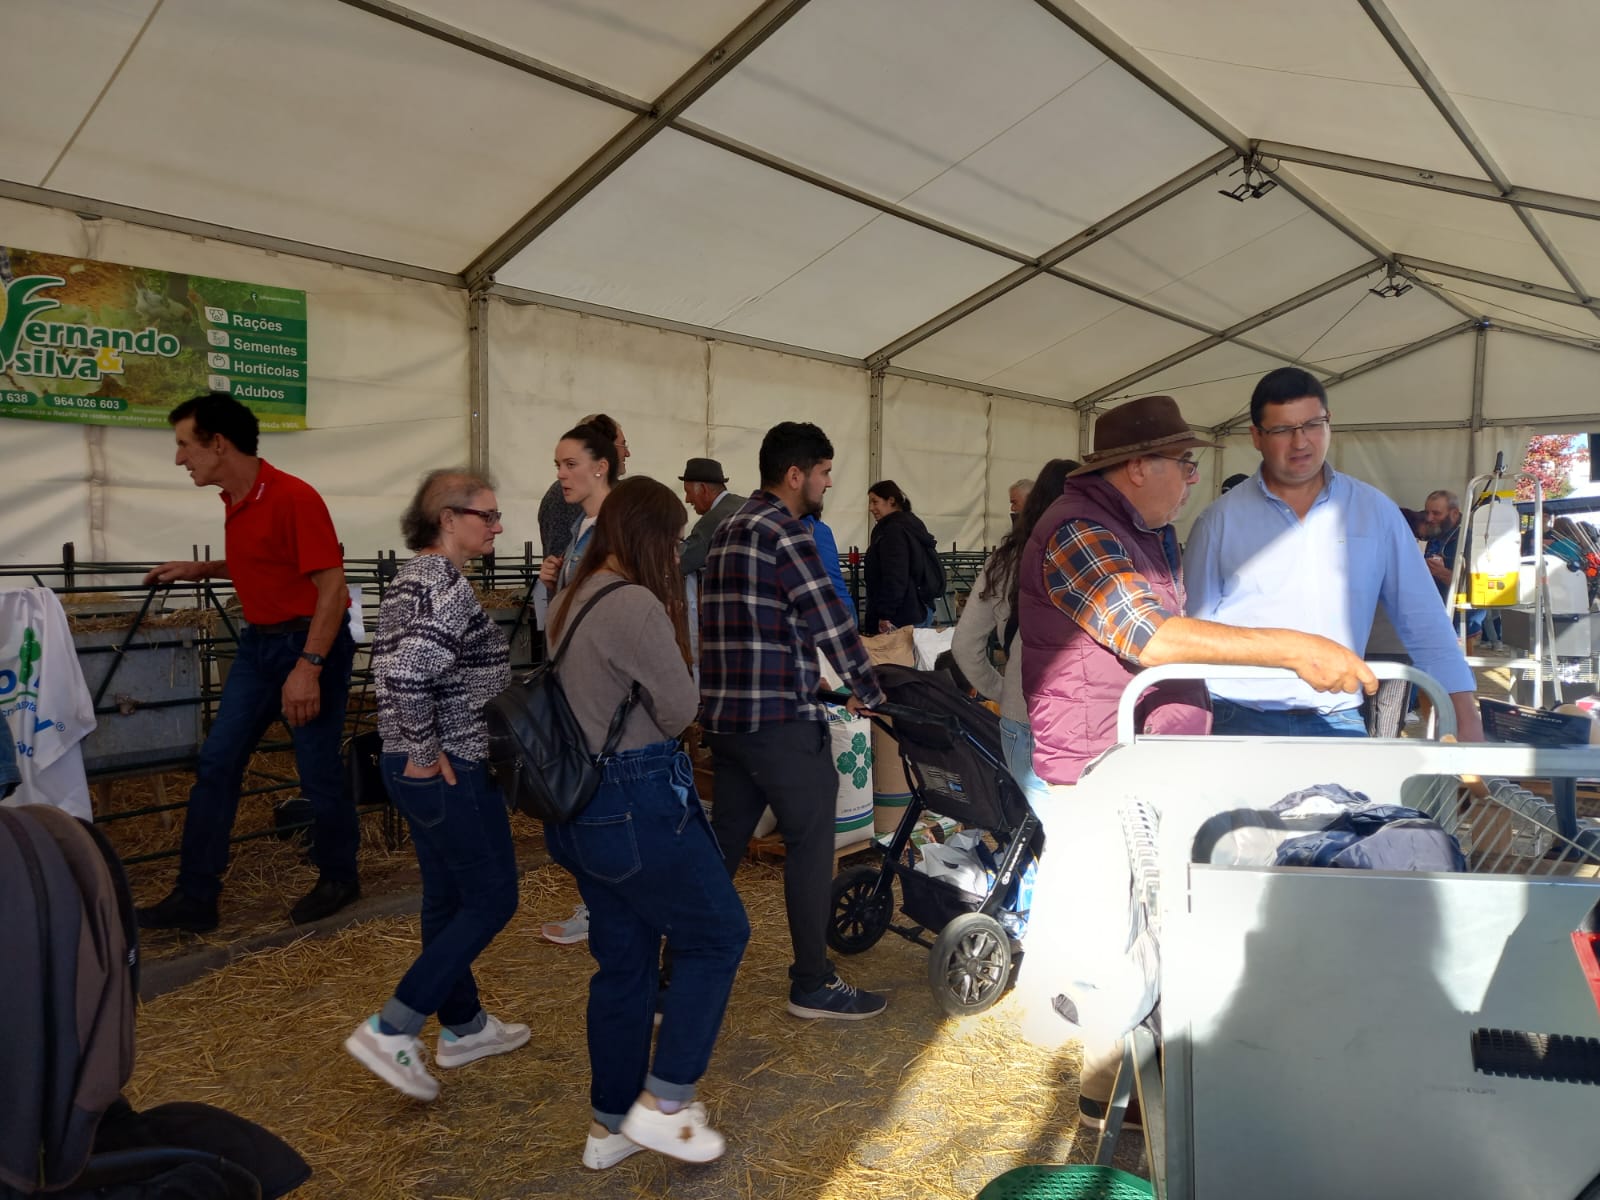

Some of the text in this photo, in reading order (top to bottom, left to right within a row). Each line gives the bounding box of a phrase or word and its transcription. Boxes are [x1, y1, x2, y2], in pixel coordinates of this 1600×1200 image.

[233, 315, 283, 331] Rações
[234, 338, 298, 356] Sementes
[15, 350, 98, 378] silva
[7, 393, 28, 403] 638
[234, 384, 285, 399] Adubos
[54, 396, 119, 409] 964 026 603
